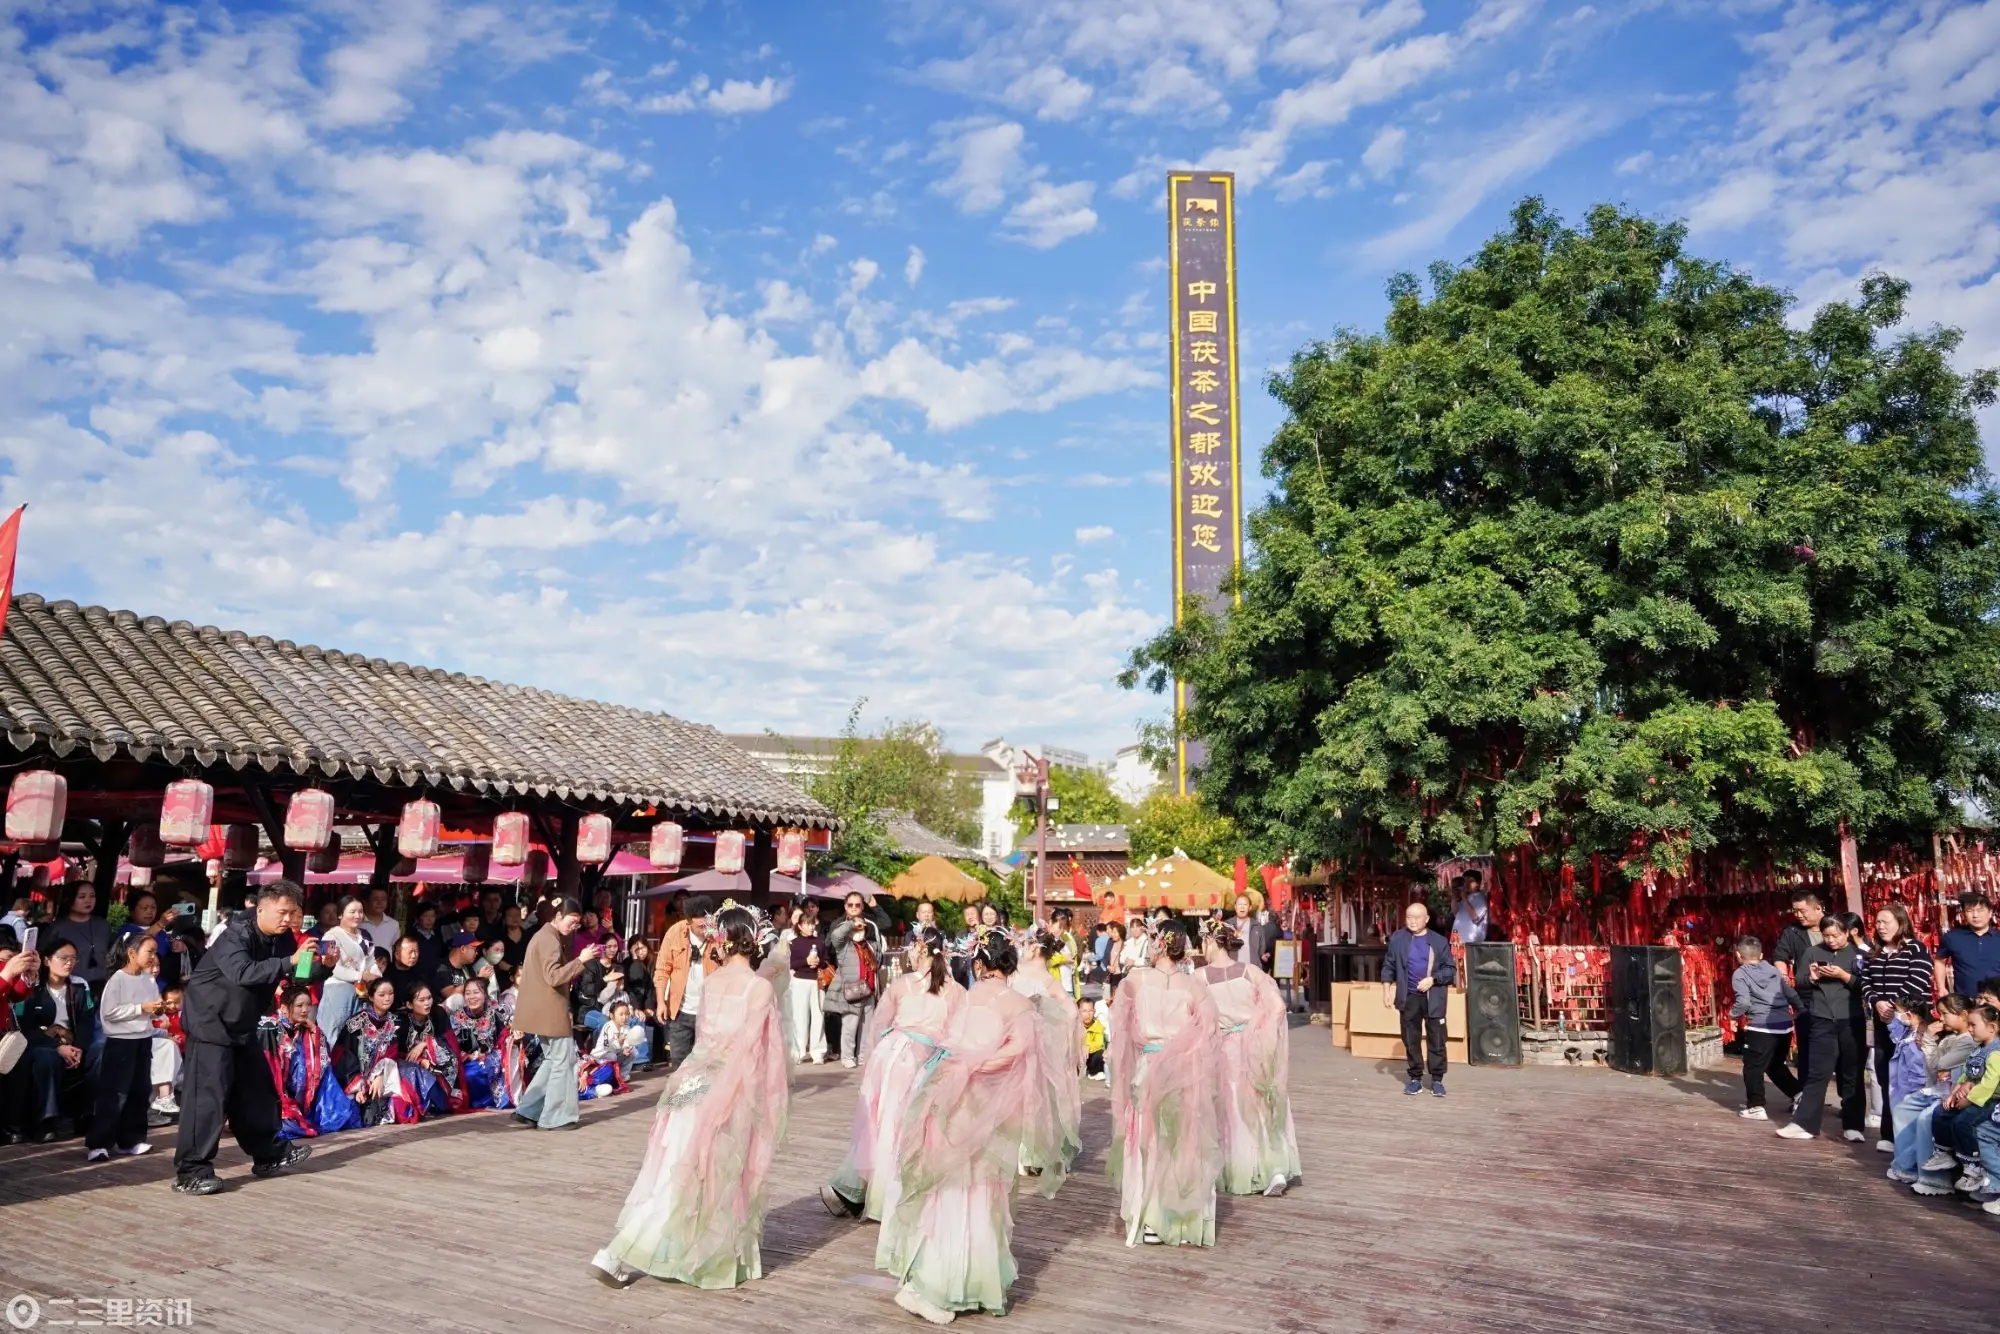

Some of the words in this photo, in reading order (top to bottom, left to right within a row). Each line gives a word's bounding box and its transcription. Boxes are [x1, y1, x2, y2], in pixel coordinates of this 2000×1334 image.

[1188, 280, 1223, 552] 中国茯茶之都欢迎您
